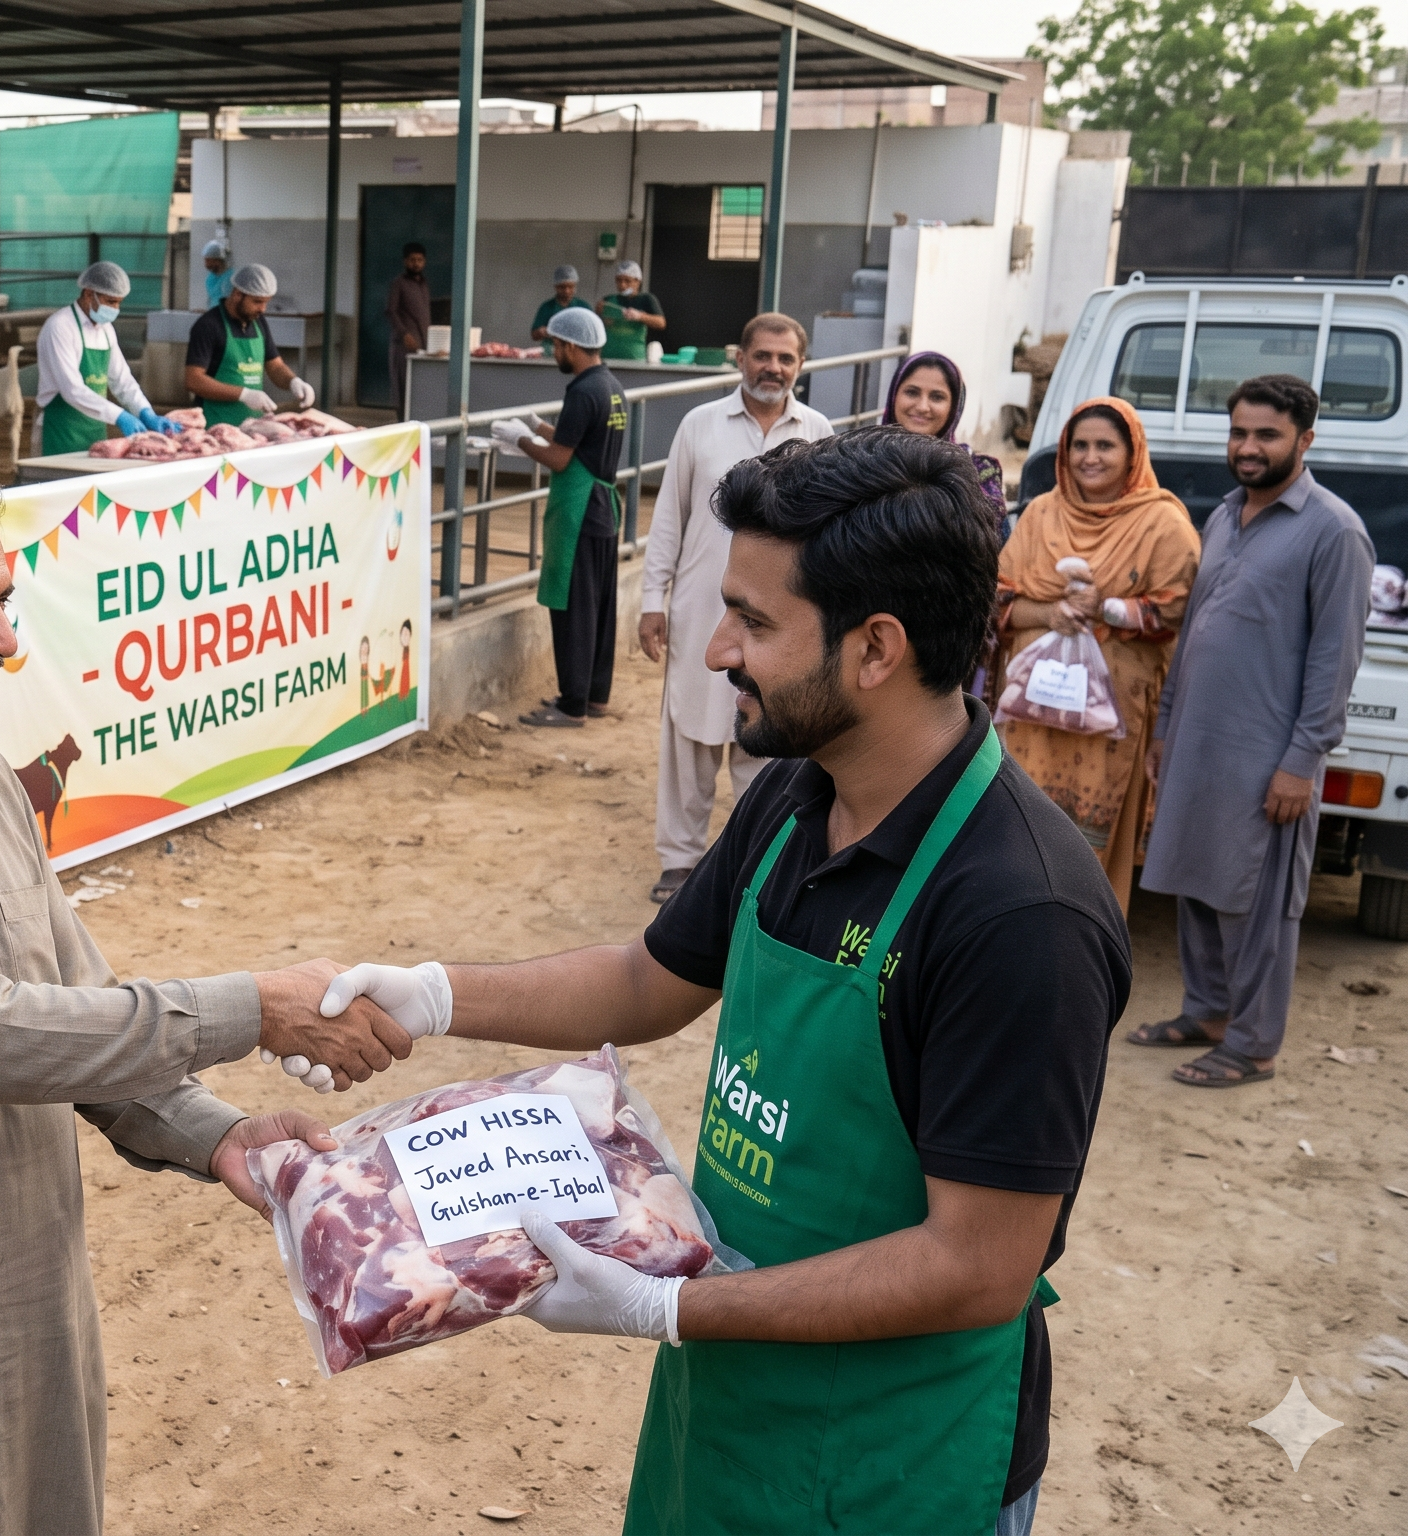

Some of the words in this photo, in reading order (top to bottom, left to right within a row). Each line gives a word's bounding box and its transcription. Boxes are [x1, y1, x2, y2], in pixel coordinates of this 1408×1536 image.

[97, 561, 164, 622] EID
[180, 548, 227, 600] UL
[238, 523, 339, 588] ADHA
[114, 581, 329, 701] QURBANI
[94, 712, 157, 765] THE
[167, 679, 264, 741] WARSI
[274, 652, 347, 703] FARM
[841, 919, 902, 979] Wasi
[408, 1120, 467, 1152] COW
[481, 1107, 562, 1132] HISSA
[714, 1045, 789, 1142] Warsi
[414, 1156, 492, 1190] Javed
[506, 1144, 589, 1168] Ansari,
[704, 1094, 774, 1186] Farm
[430, 1176, 605, 1222] Gulshan-e-Iqbal
